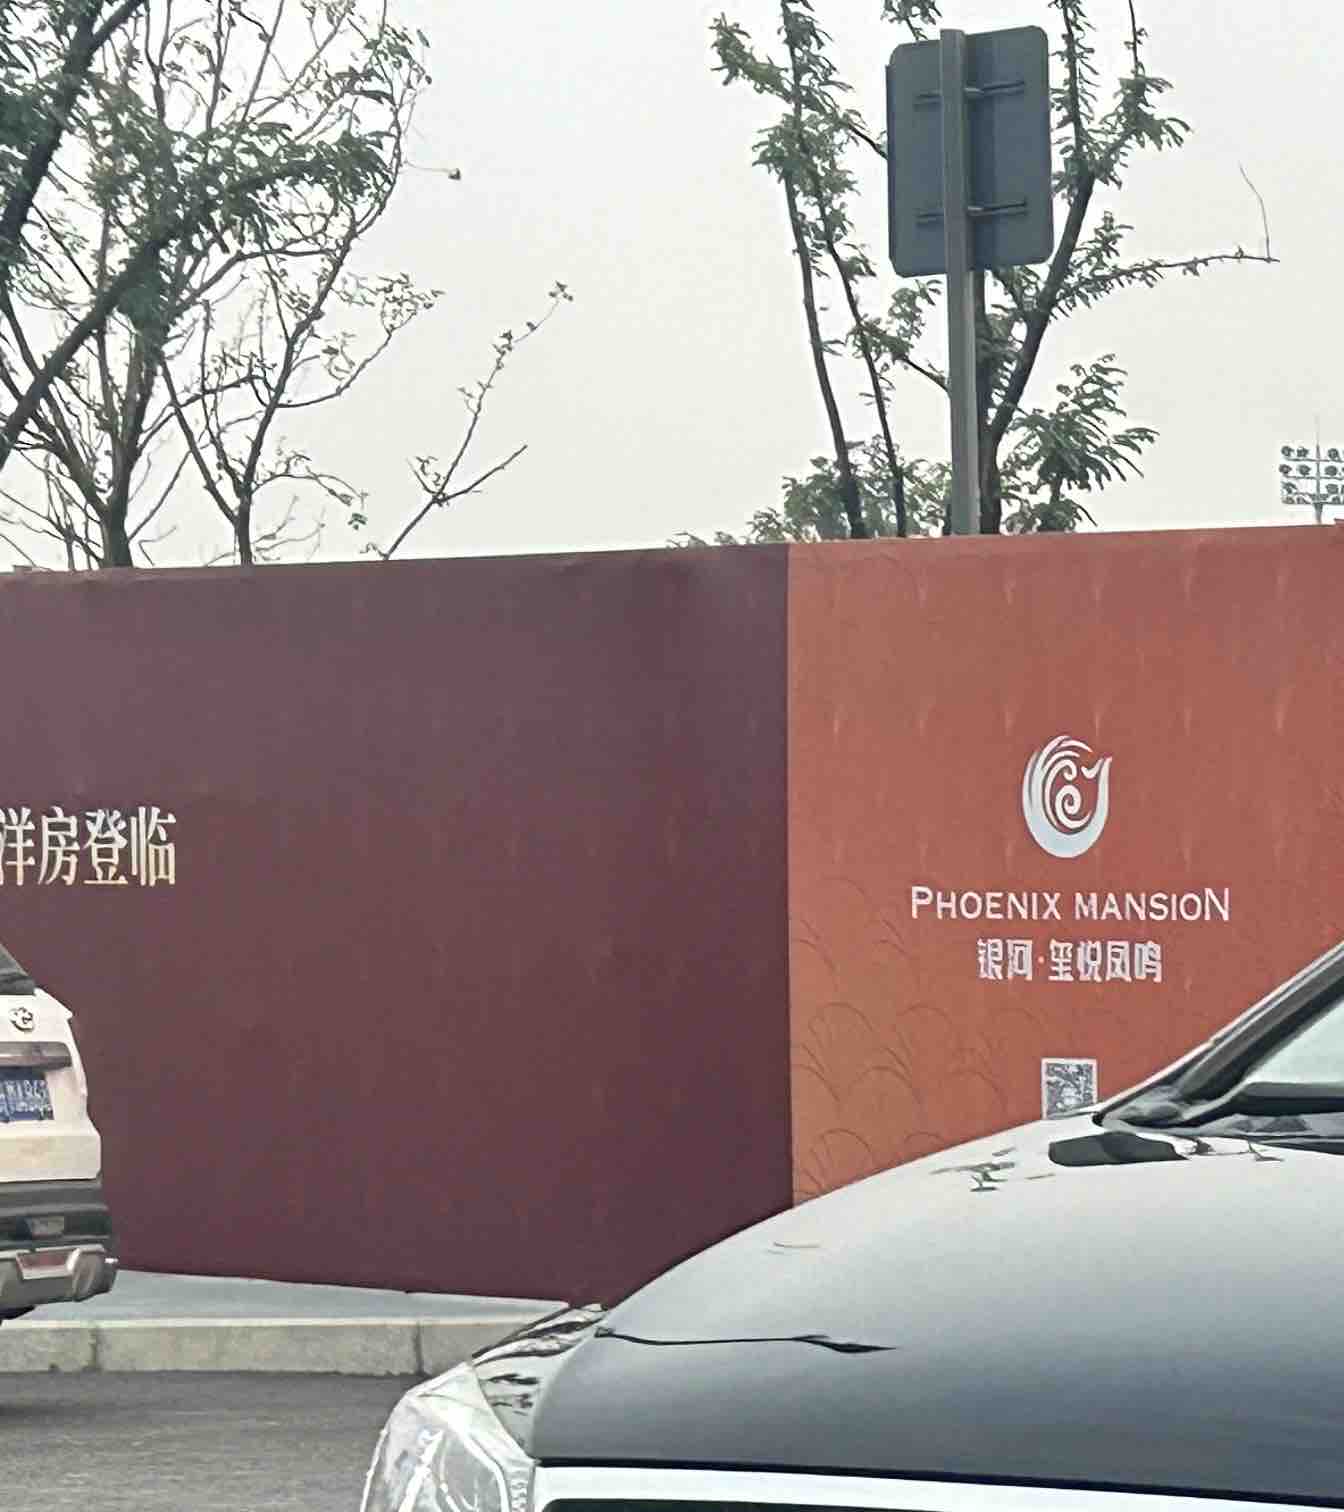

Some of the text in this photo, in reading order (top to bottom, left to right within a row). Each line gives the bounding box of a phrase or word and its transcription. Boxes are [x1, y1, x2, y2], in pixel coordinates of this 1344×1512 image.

[0, 806, 177, 886] 洋房登临
[911, 886, 1230, 921] PHOENIX MANSION
